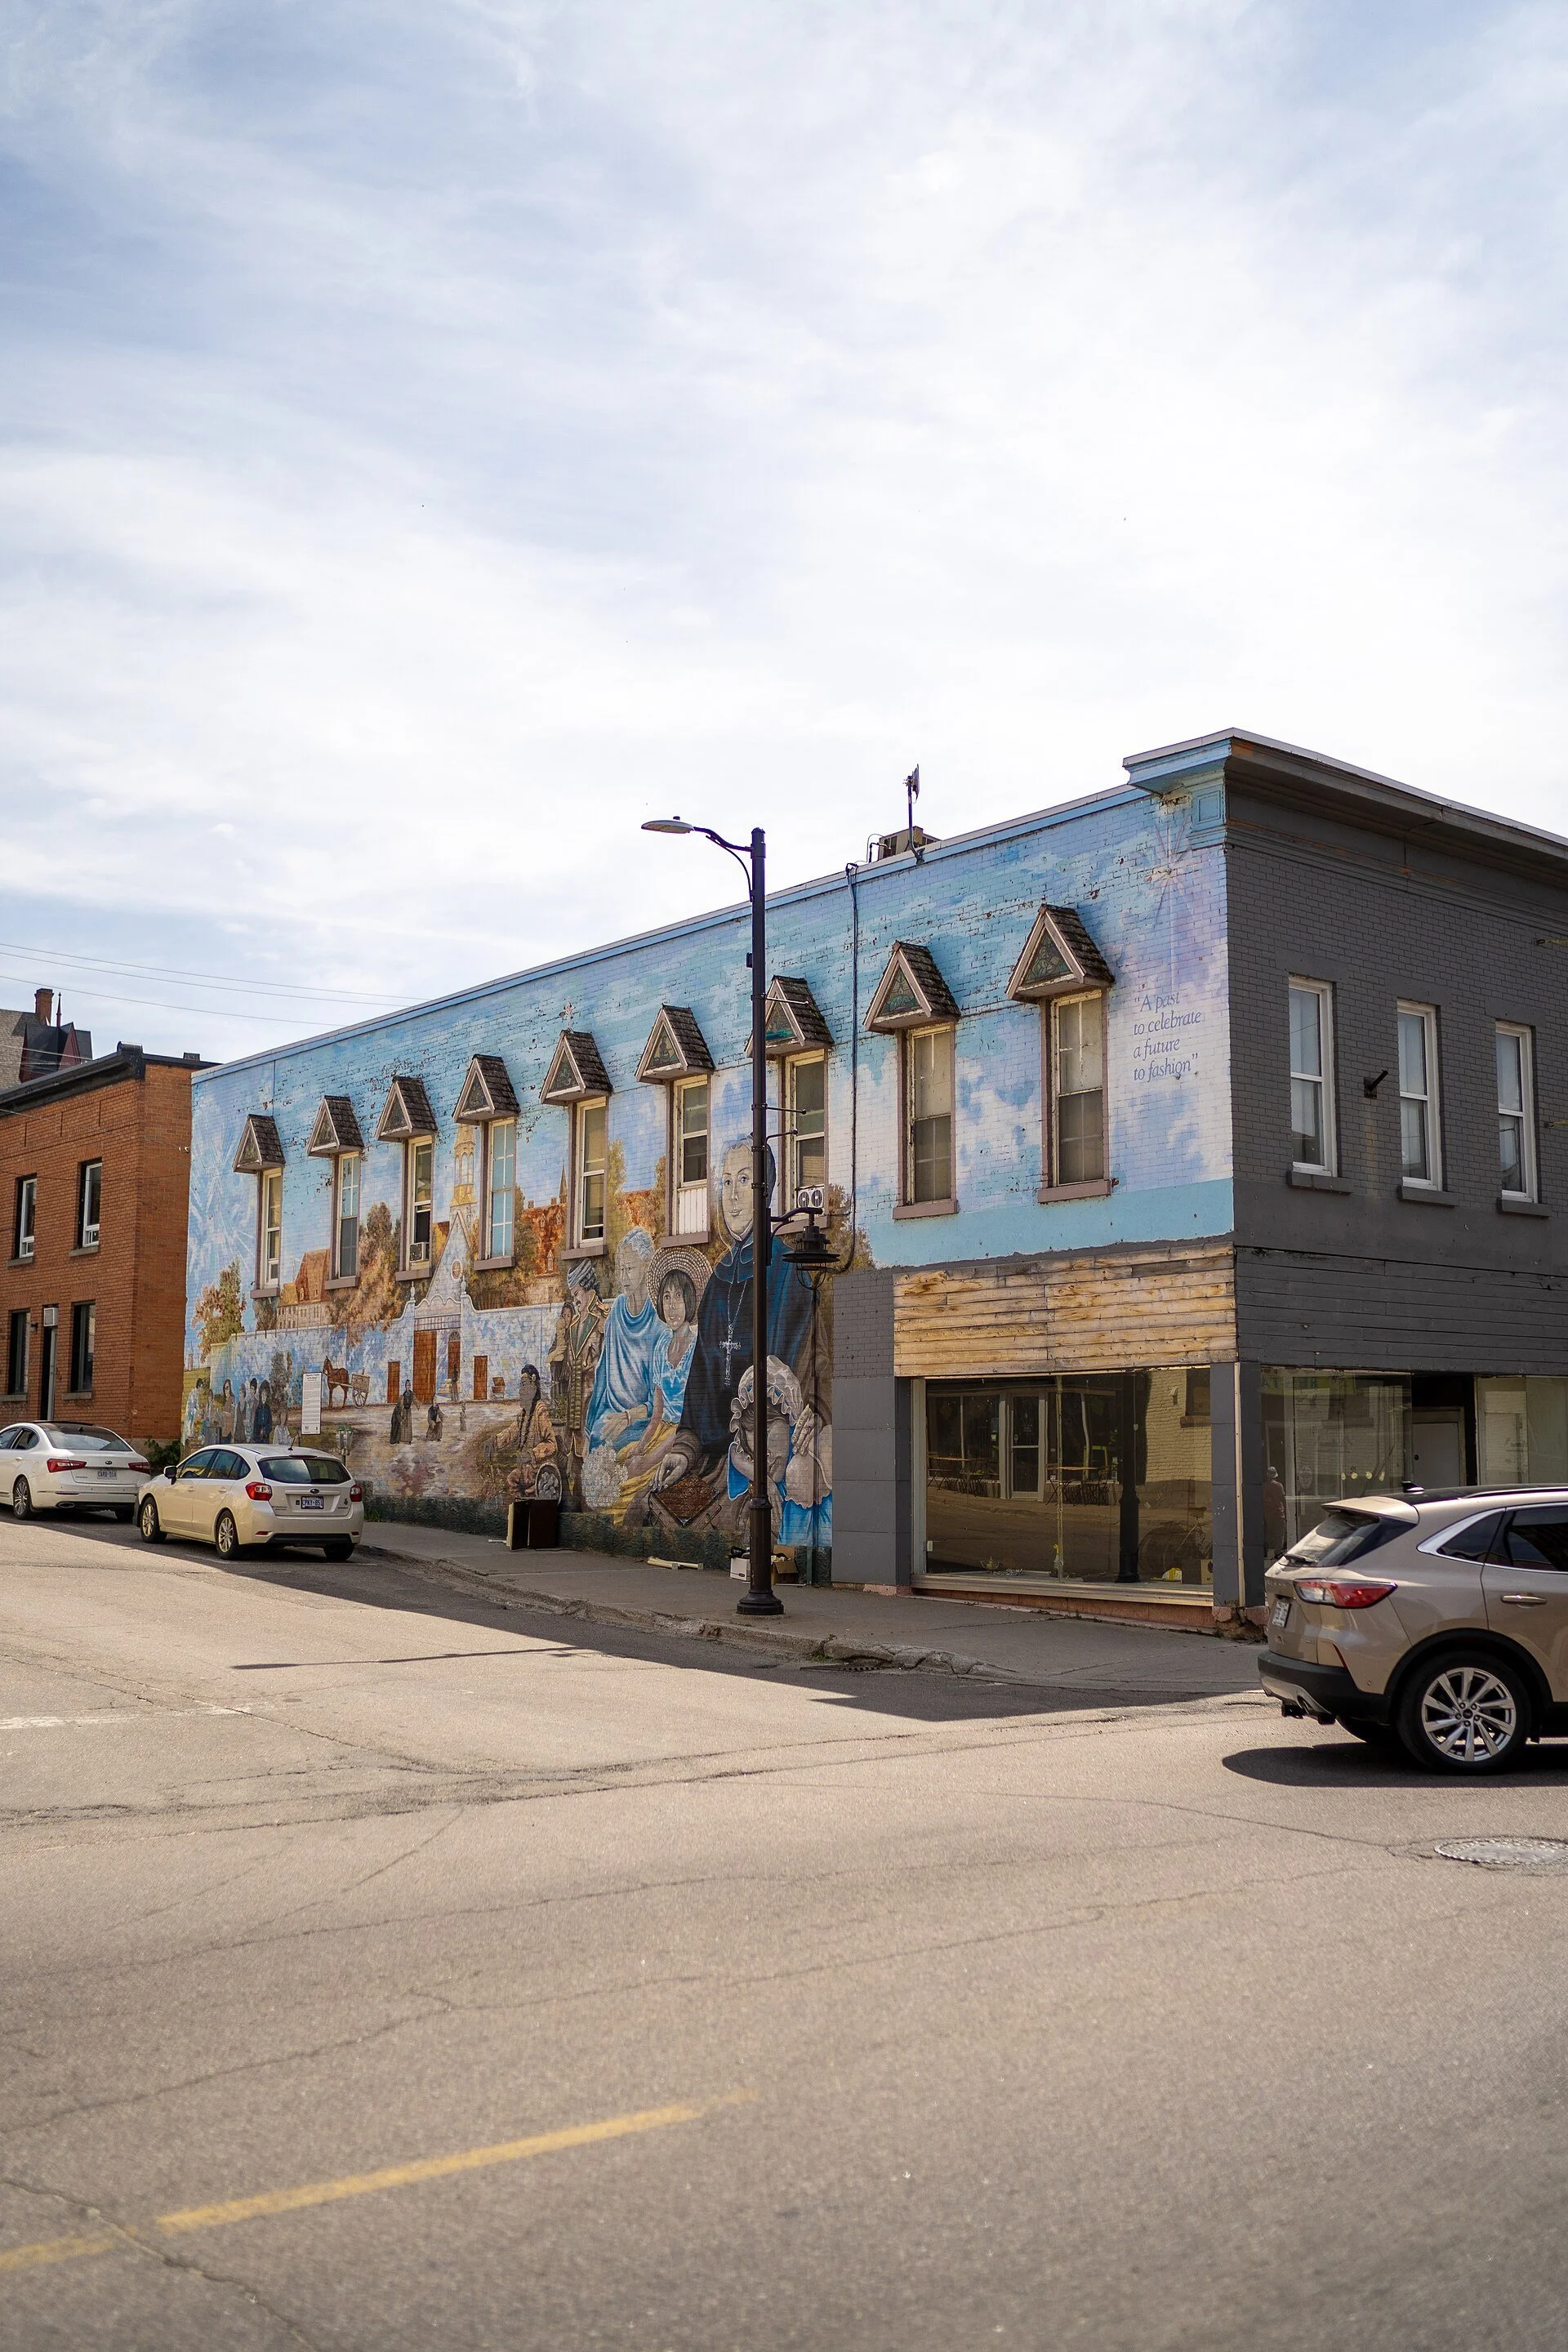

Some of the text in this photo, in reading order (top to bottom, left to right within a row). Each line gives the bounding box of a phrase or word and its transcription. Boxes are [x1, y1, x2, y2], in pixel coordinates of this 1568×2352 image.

[1155, 991, 1180, 1013] past
[1134, 1010, 1201, 1036] to celebrate
[1133, 1037, 1180, 1061] a future
[1134, 1068, 1145, 1080] to
